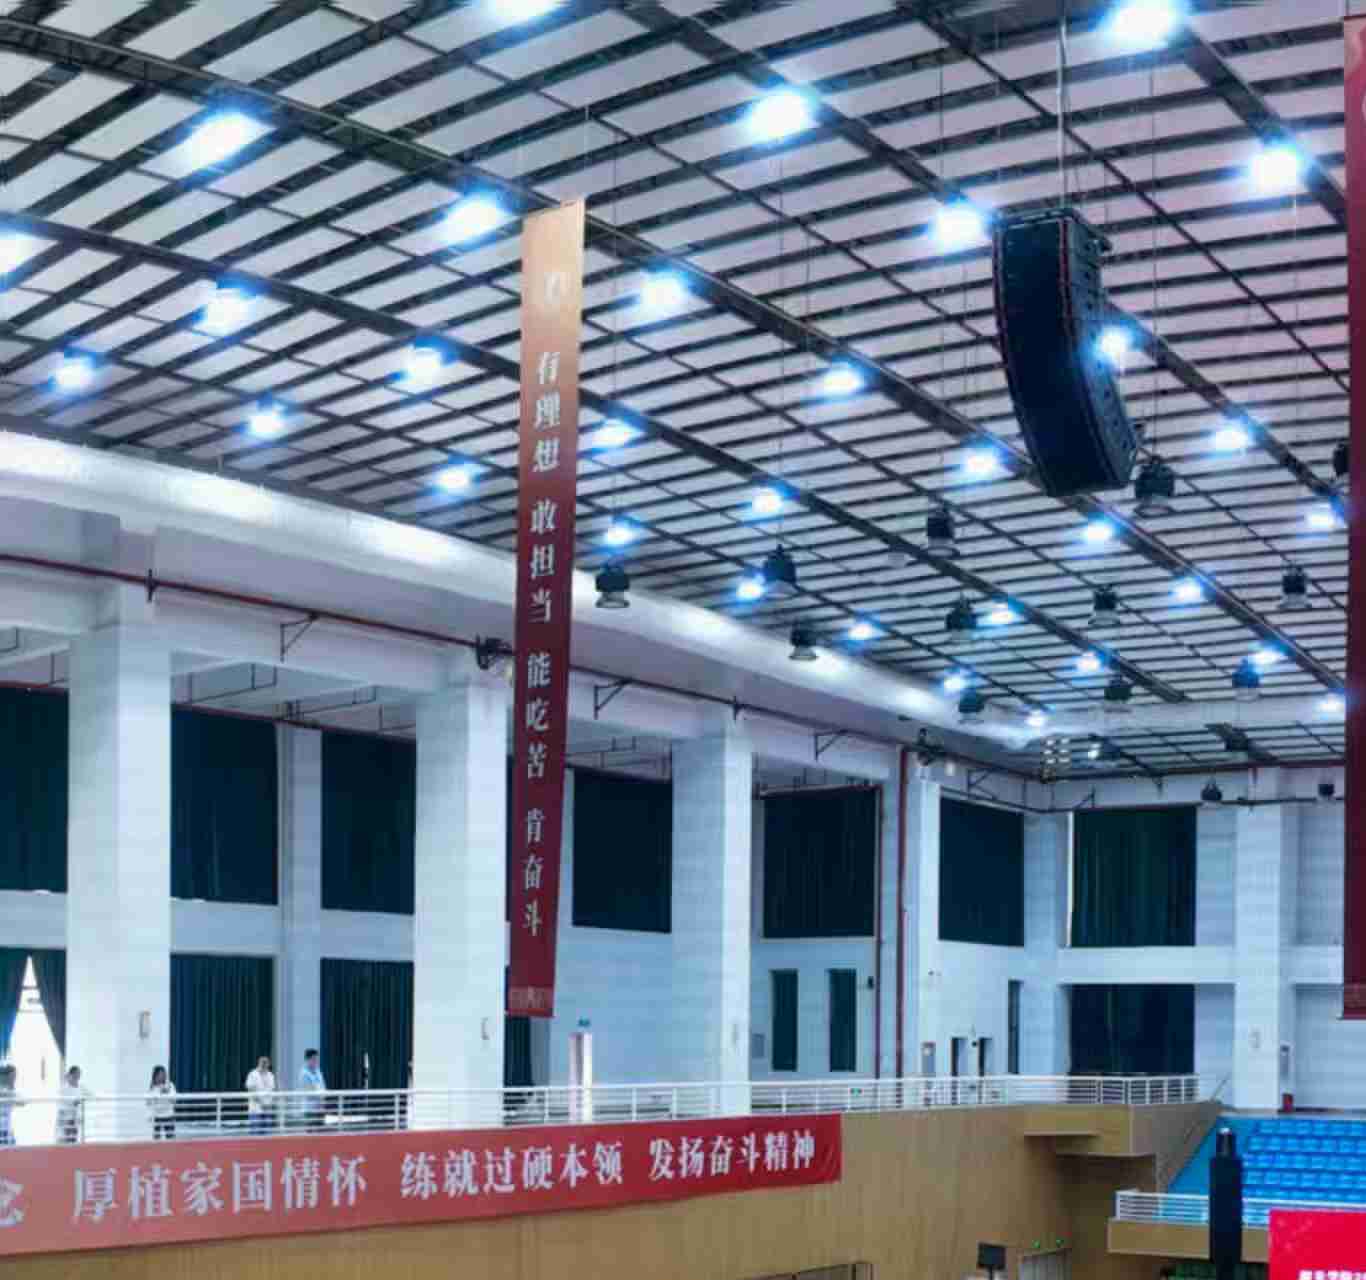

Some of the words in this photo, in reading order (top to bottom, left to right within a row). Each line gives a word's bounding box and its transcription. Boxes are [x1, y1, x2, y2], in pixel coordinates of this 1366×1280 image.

[529, 498, 557, 623] 敢担当
[525, 652, 551, 779] 能吃苦
[522, 806, 547, 937] 肯奋斗
[72, 1153, 367, 1225] 厚植家国情怀
[400, 1140, 624, 1201] 练就过硬本领
[649, 1129, 816, 1182] 发扬奋斗精神
